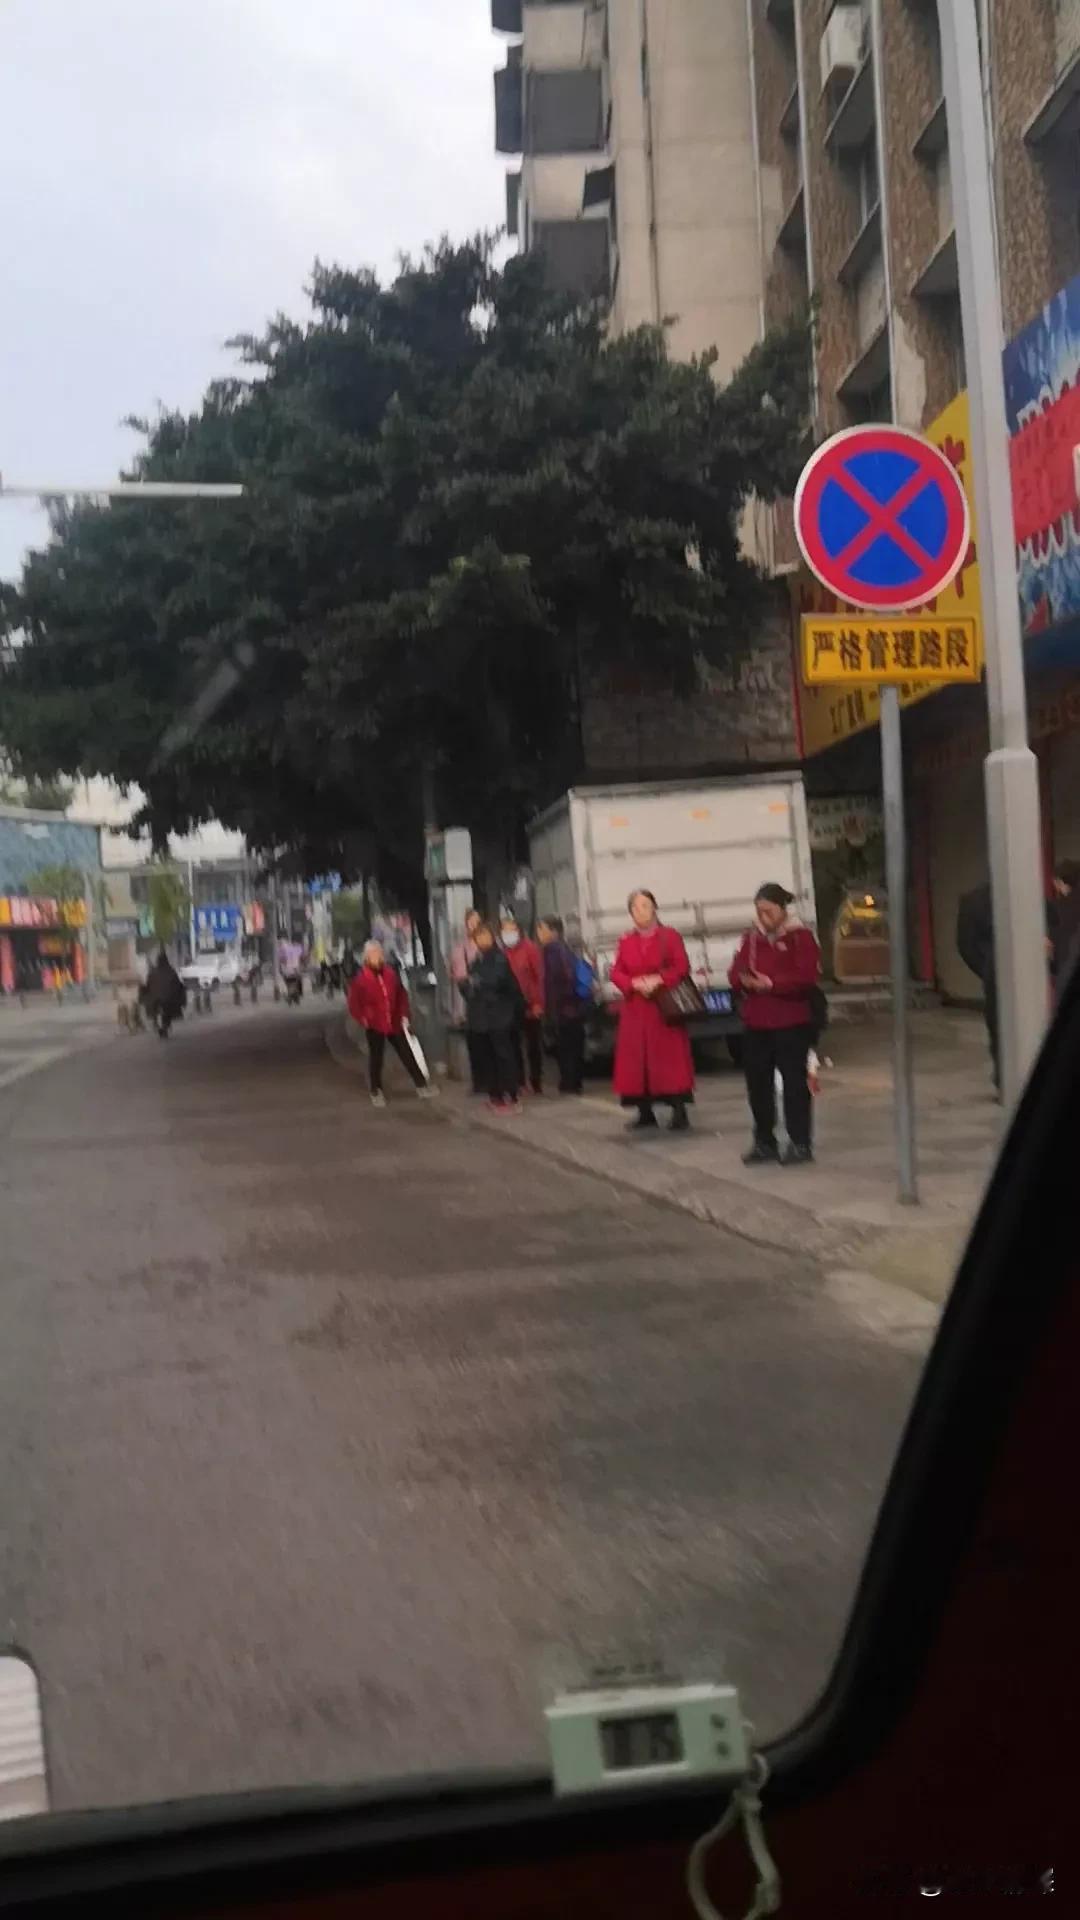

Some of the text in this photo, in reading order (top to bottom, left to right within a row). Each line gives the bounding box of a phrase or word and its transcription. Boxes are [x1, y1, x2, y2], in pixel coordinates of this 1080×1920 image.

[812, 628, 969, 670] 严格管理路段
